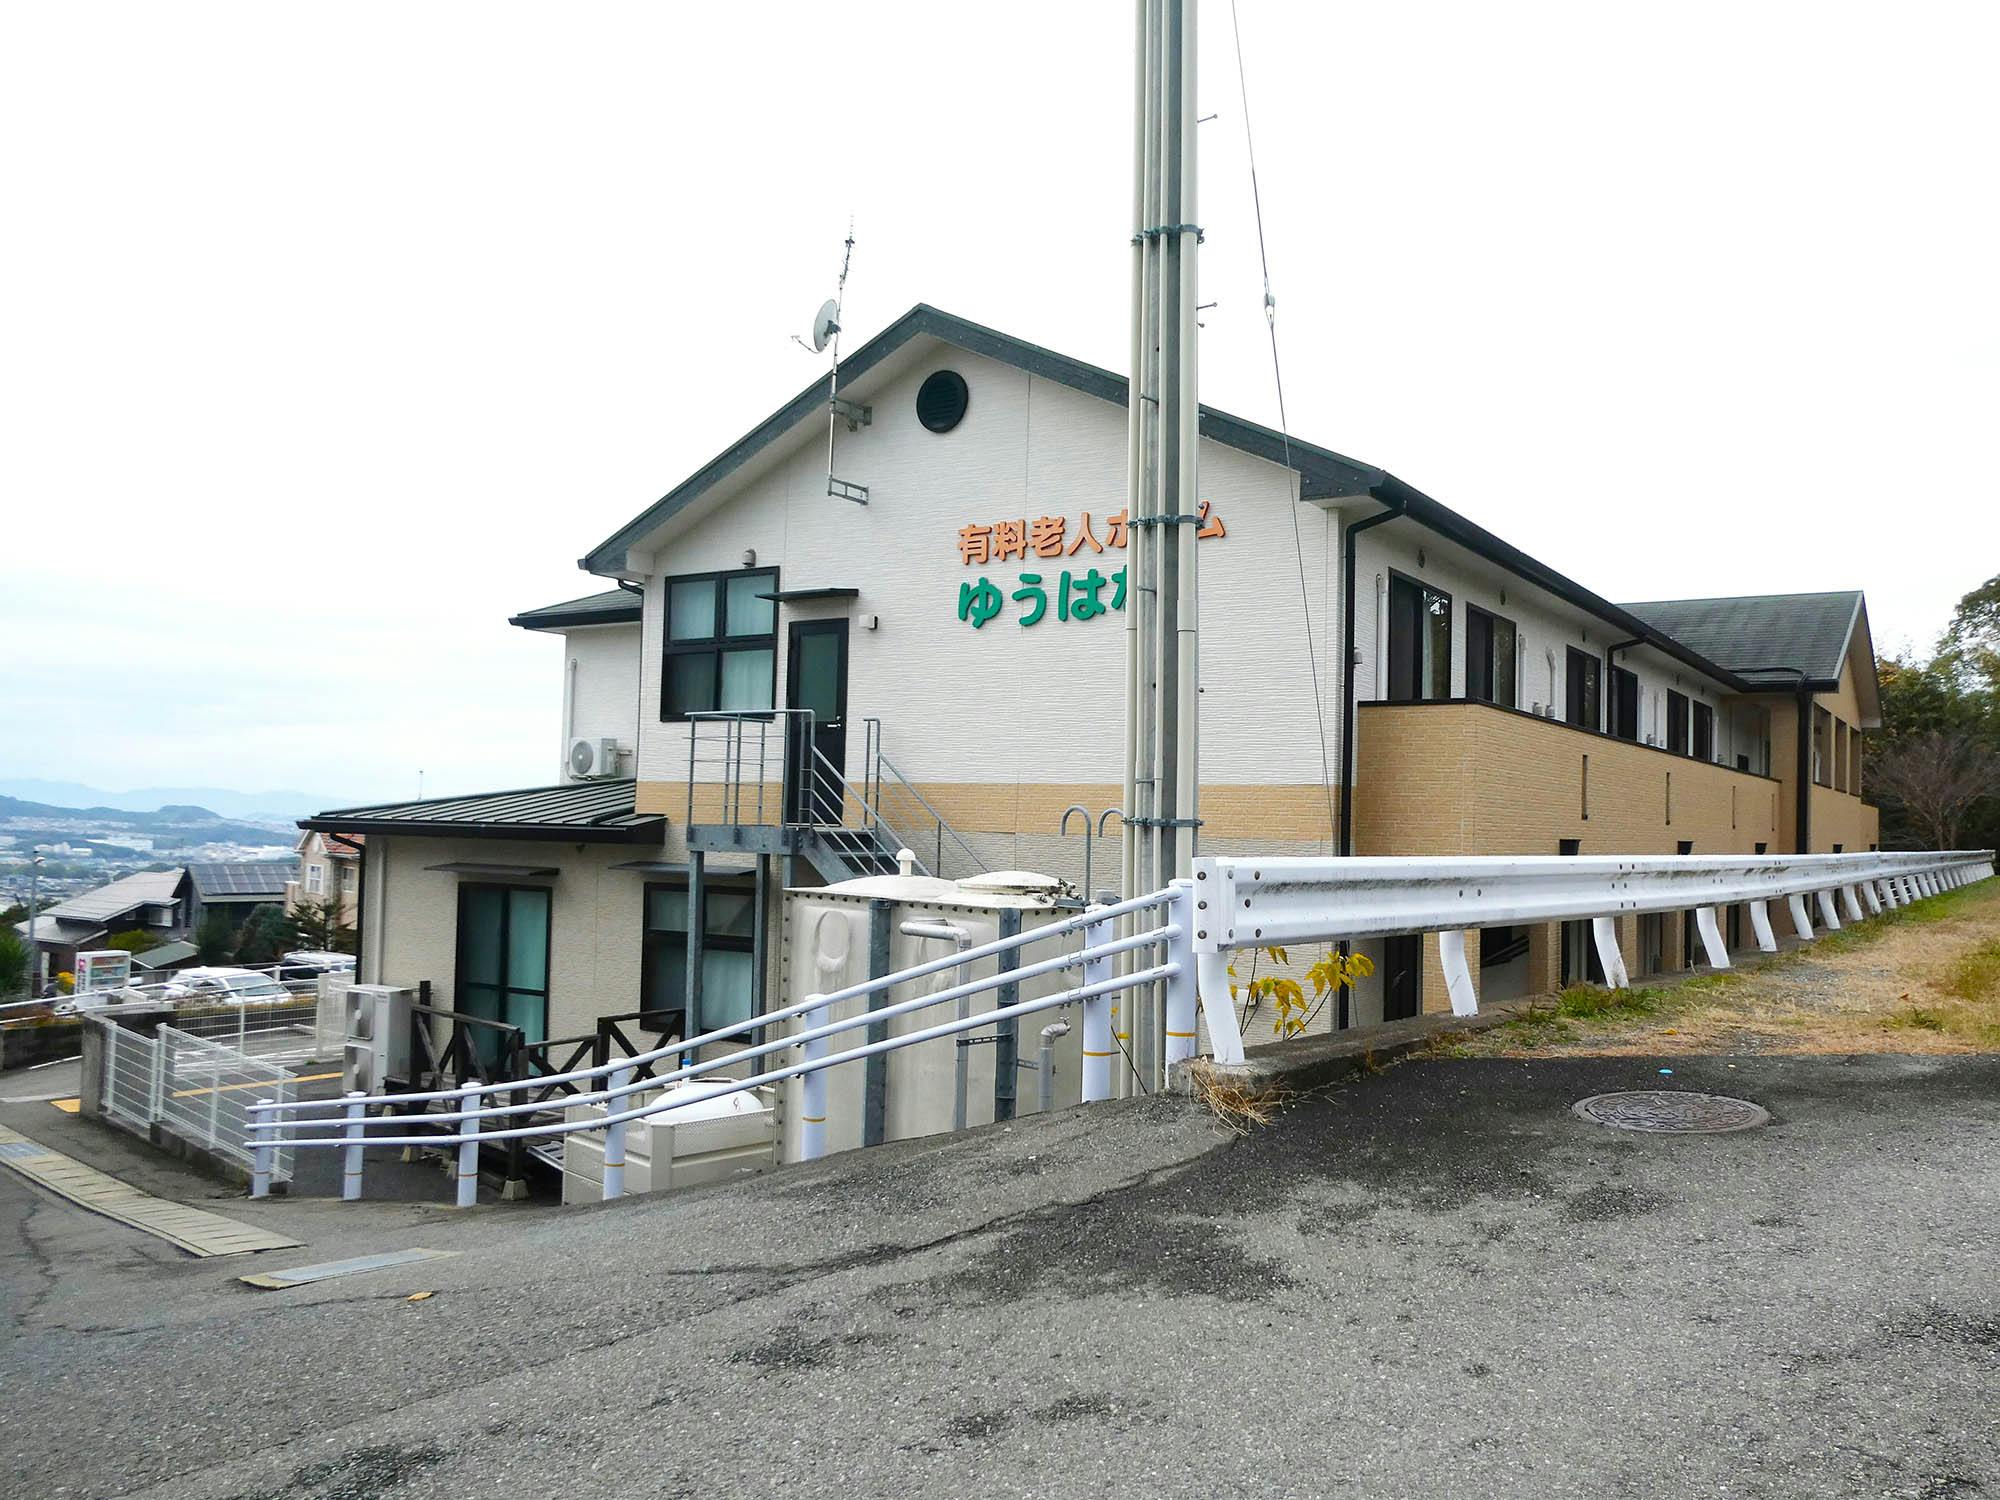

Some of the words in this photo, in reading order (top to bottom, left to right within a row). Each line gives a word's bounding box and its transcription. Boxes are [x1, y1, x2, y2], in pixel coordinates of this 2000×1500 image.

[957, 500, 1226, 565] 有料老人ホム
